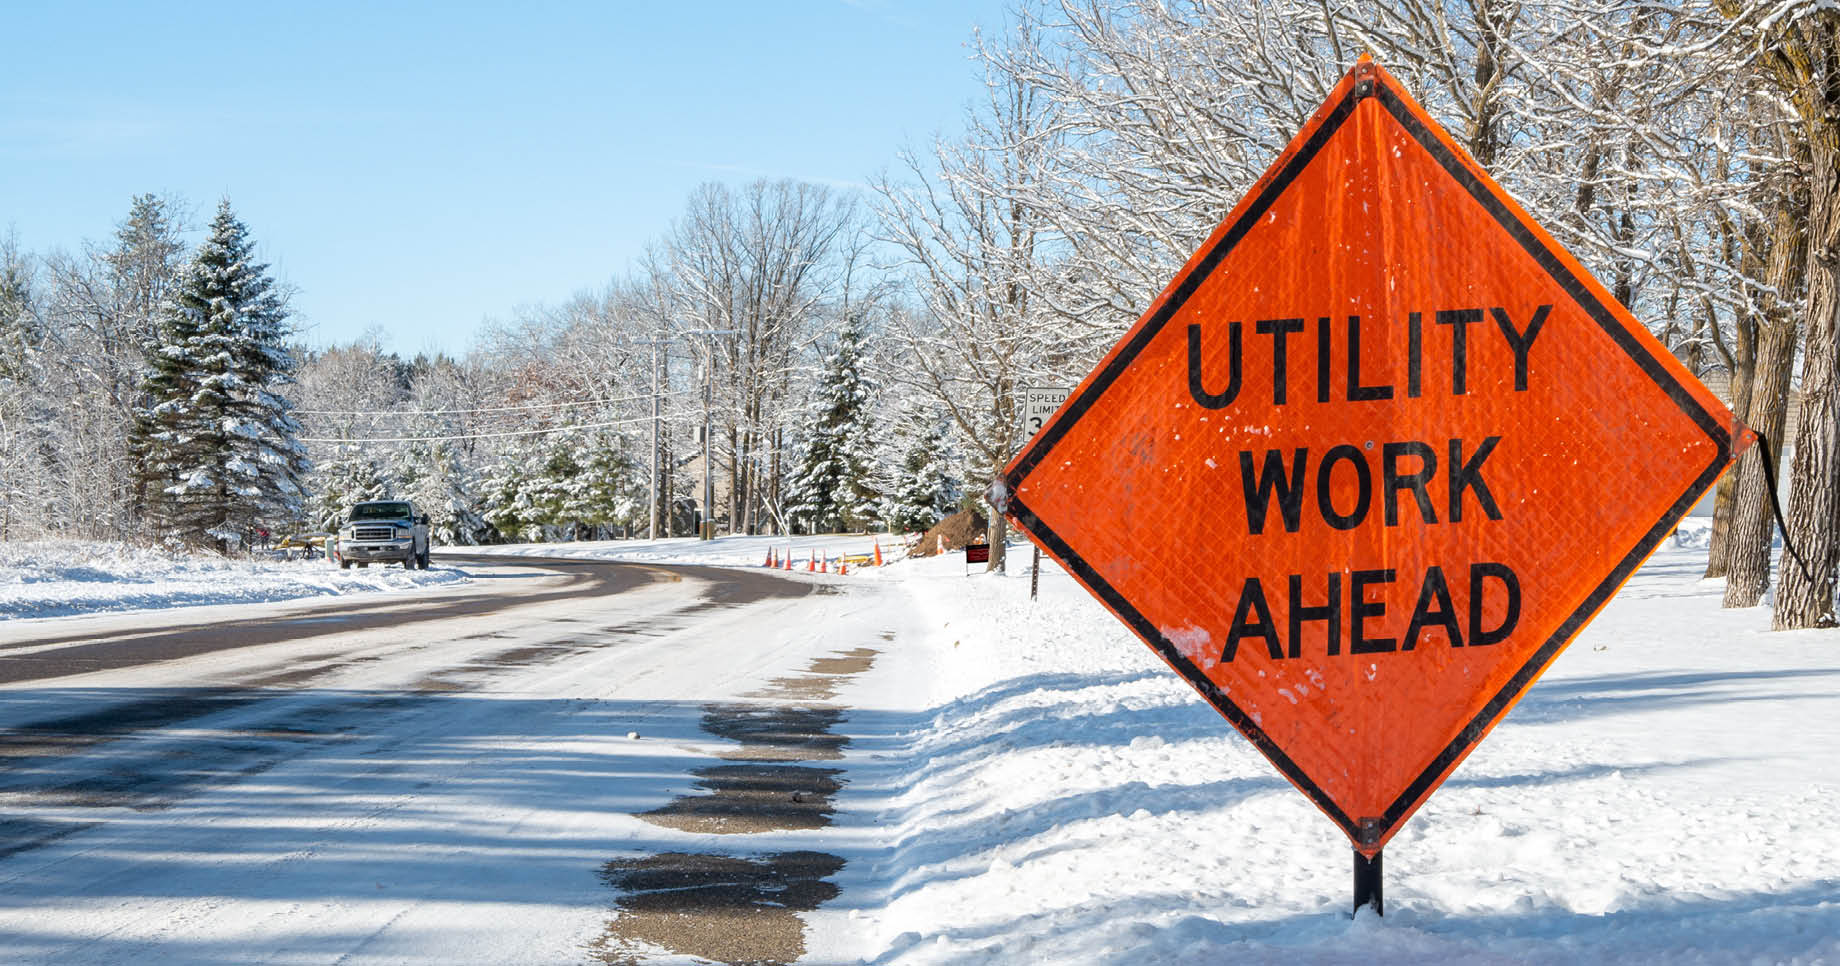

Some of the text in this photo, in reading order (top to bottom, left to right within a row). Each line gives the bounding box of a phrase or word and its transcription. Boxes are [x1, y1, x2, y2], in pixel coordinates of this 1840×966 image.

[1029, 393, 1066, 403] SPEED
[1188, 304, 1553, 410] UTILITY
[1239, 436, 1503, 535] WORK
[1220, 562, 1522, 663] AHEAD
